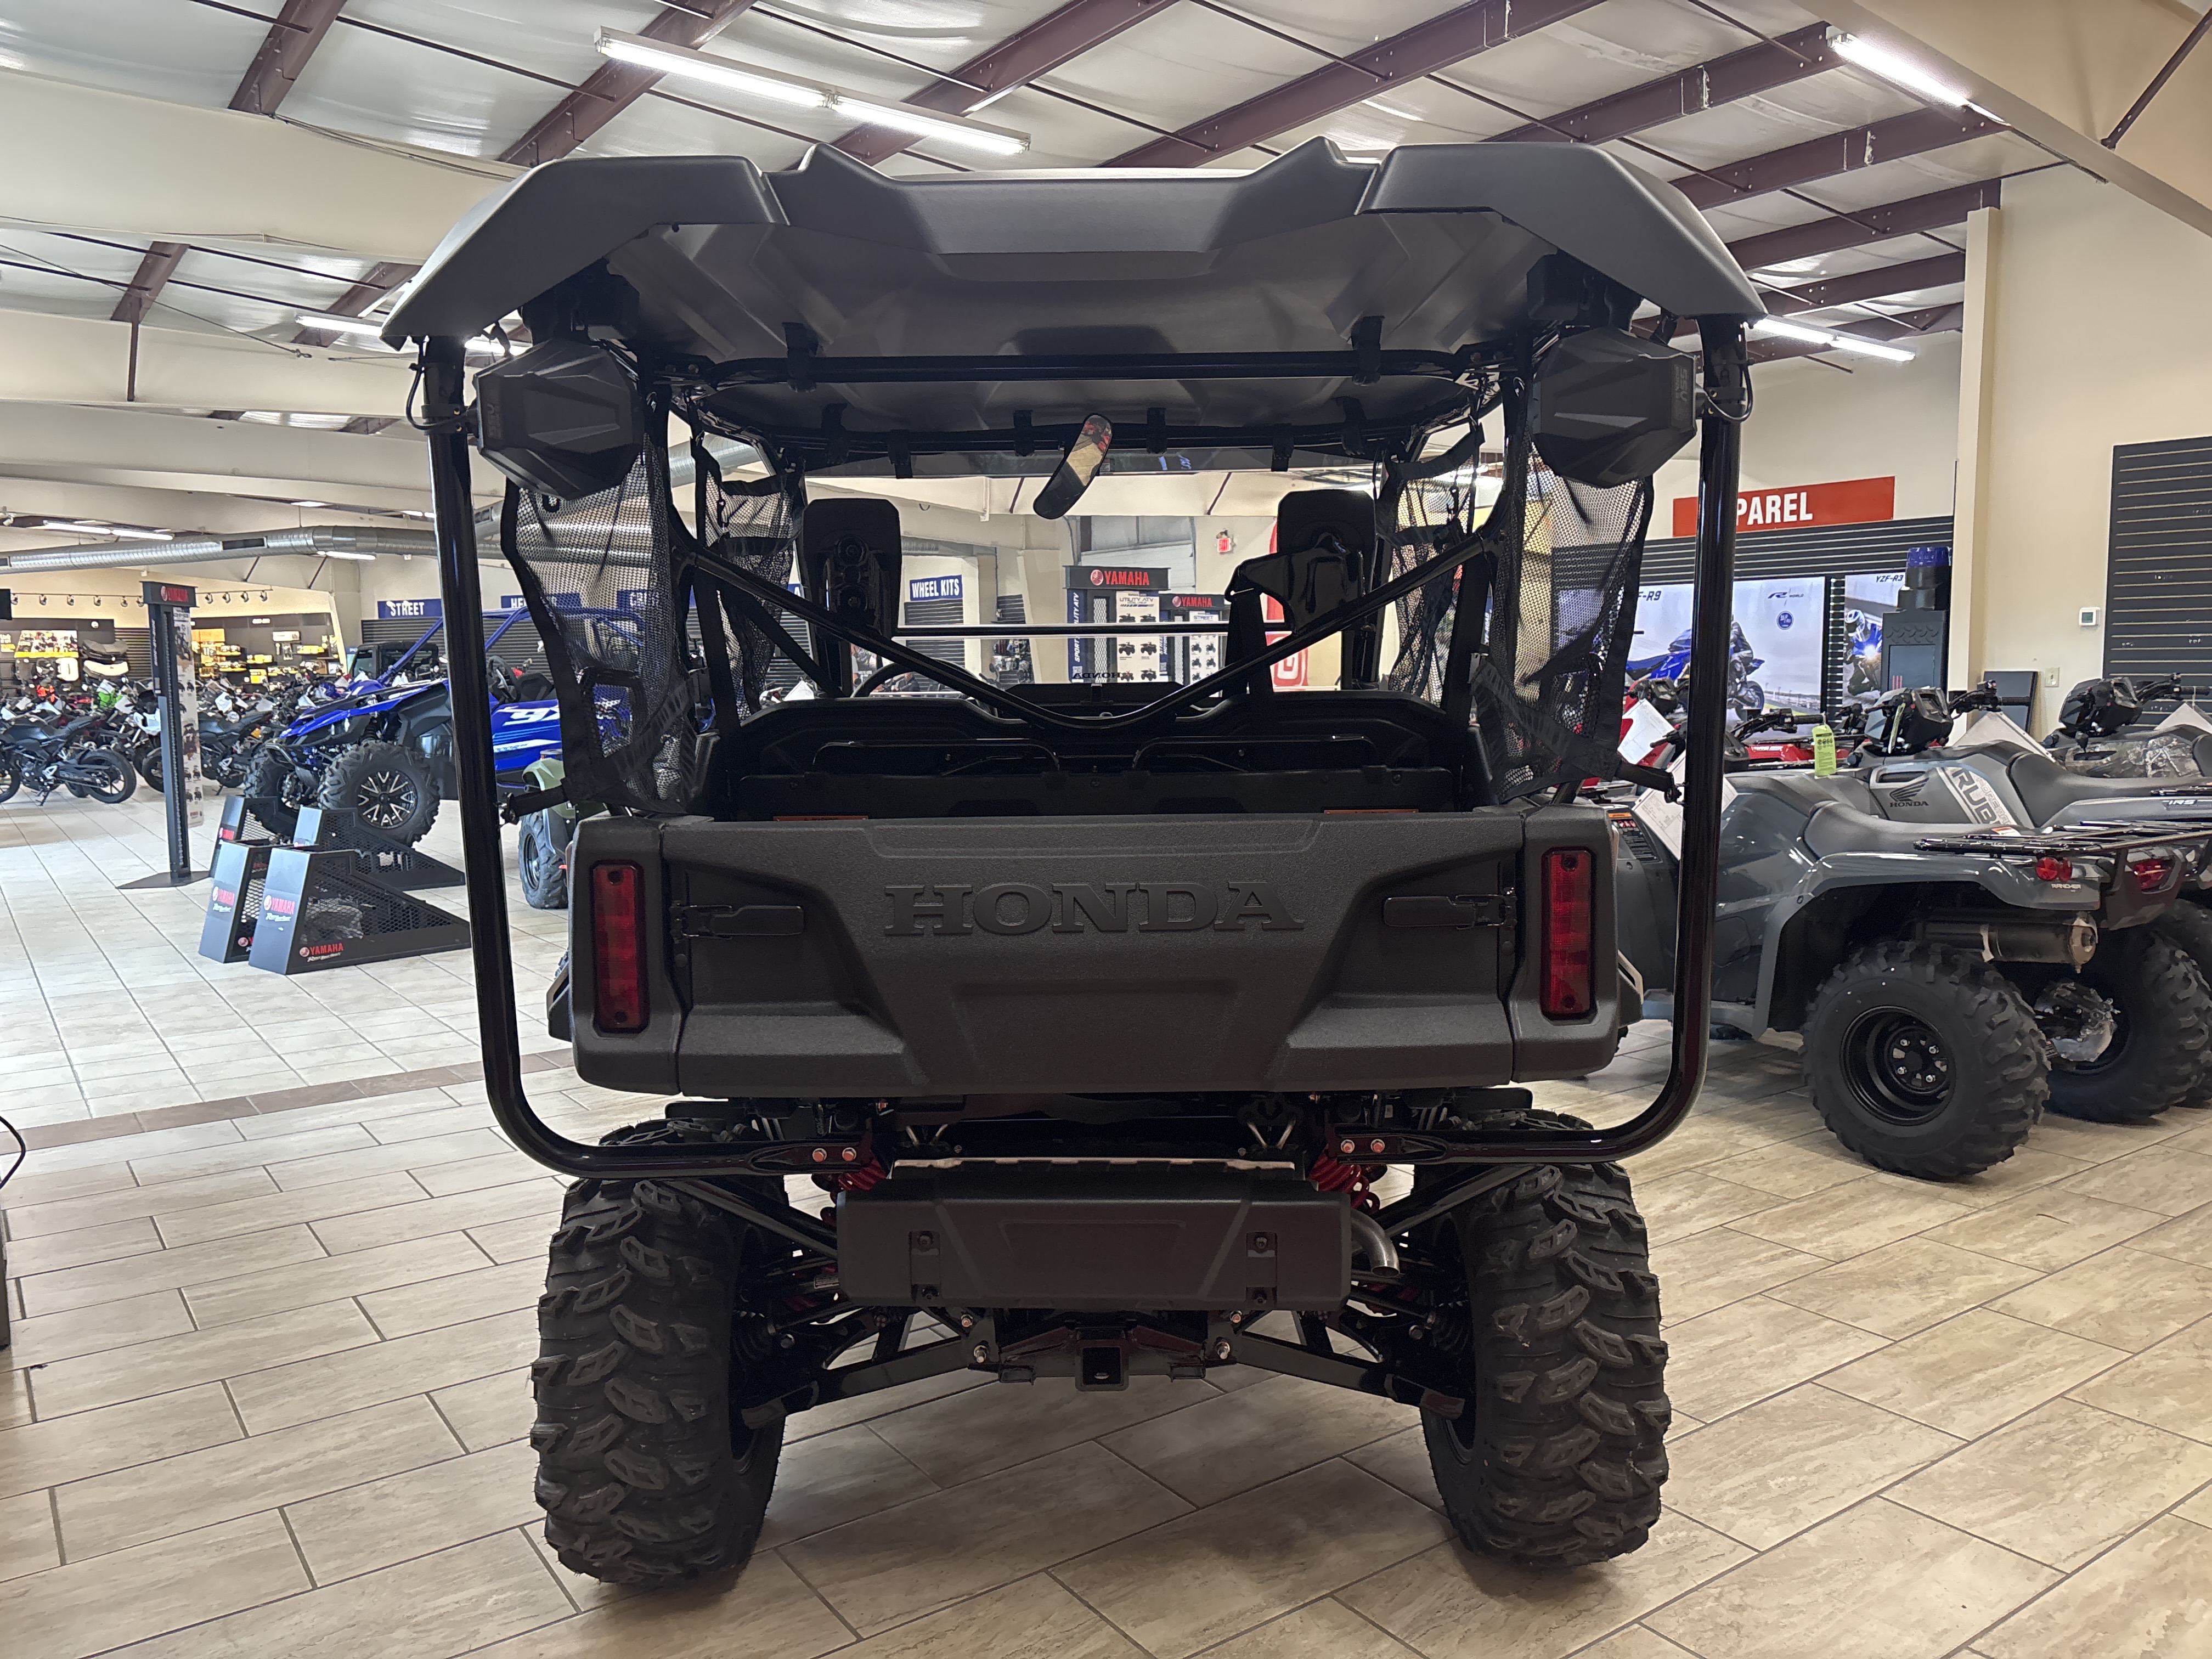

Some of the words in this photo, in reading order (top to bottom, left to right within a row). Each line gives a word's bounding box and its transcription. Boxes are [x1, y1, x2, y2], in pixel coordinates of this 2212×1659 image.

[1104, 571, 1150, 585] YAMAHA
[1876, 574, 1904, 583] YZF-R3
[912, 580, 939, 598] WHEEL
[940, 578, 960, 596] KITS
[390, 602, 425, 617] STREET
[1182, 597, 1212, 608] YAMAHA
[1951, 768, 2002, 824] RUB
[1976, 777, 2012, 824] FOREMA
[271, 897, 295, 915] YAMAHA
[884, 882, 1305, 935] HONDA
[309, 943, 343, 956] YAMAHA
